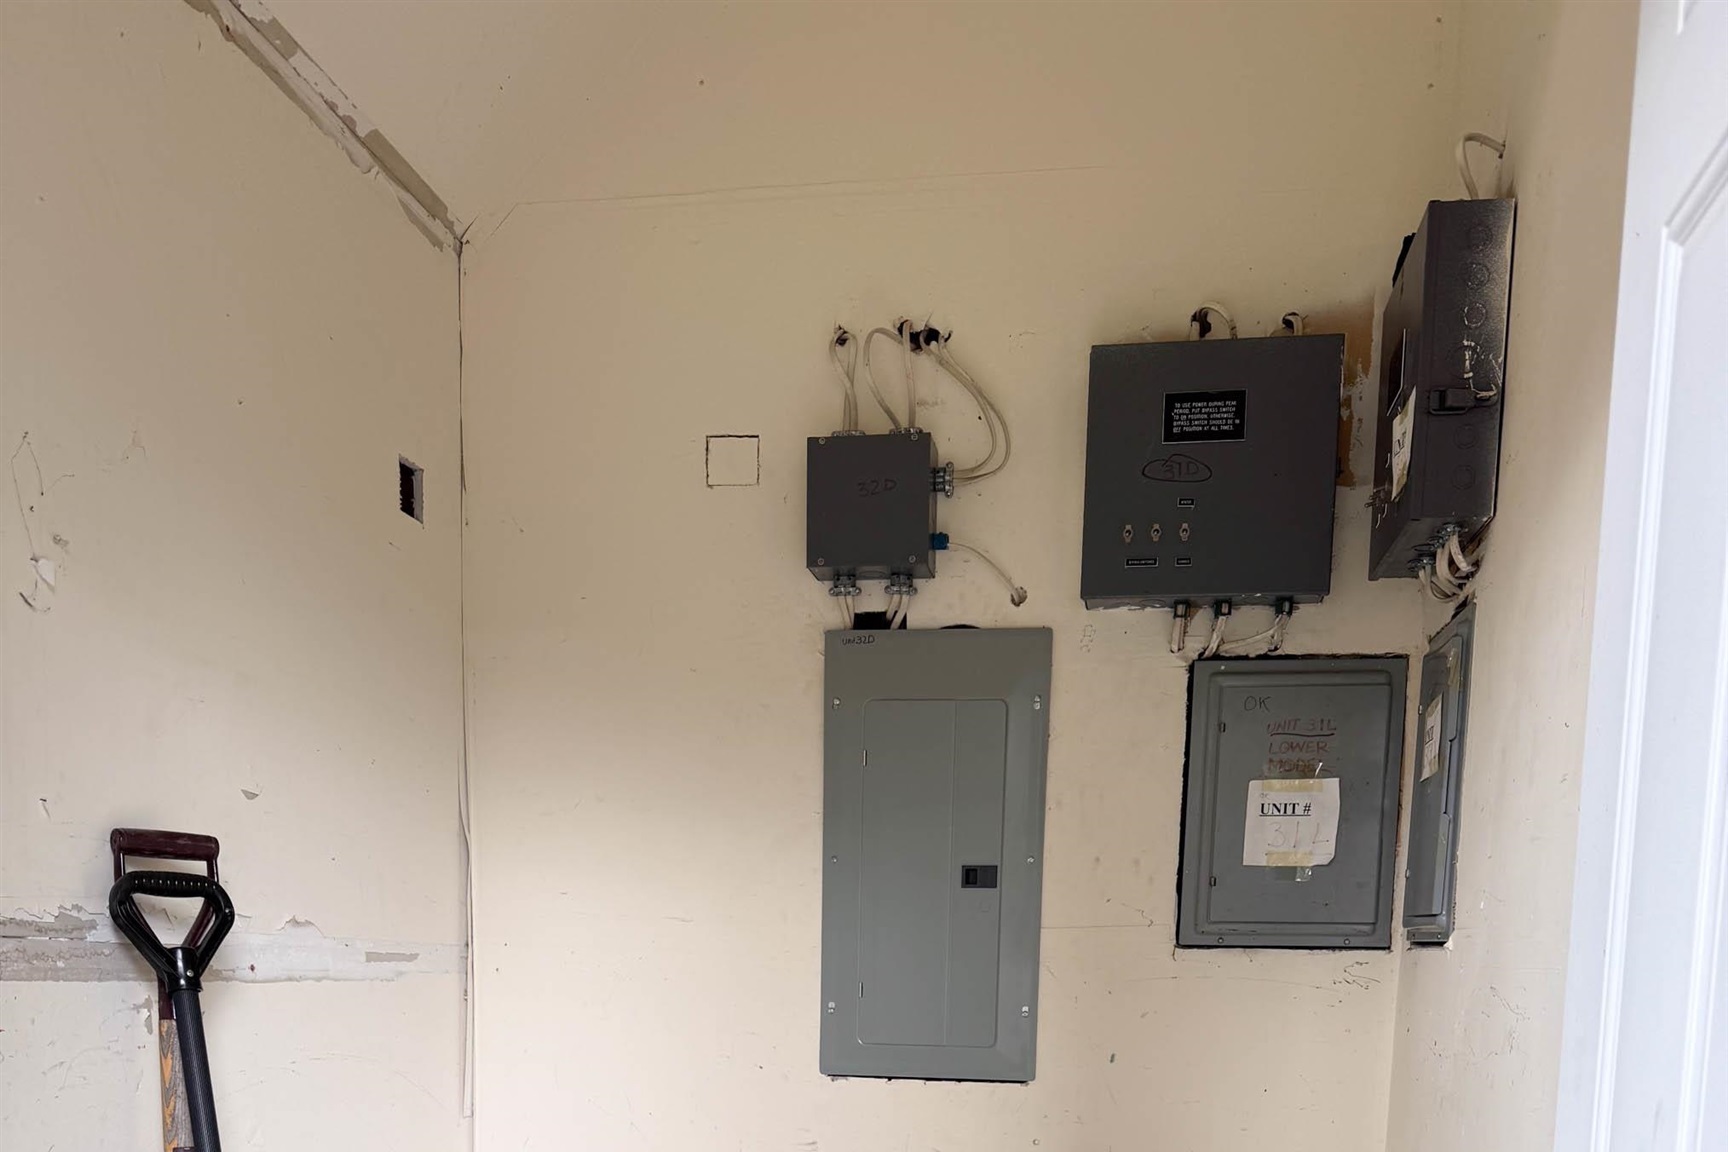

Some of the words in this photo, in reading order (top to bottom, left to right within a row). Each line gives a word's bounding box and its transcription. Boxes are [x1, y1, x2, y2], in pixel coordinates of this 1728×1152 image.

[857, 478, 898, 497] 32D
[1244, 696, 1272, 712] OK
[1266, 718, 1301, 734] UNIT
[1305, 717, 1337, 733] 31L
[1268, 740, 1330, 755] LOWER
[1260, 802, 1300, 815] UNIT
[1302, 802, 1312, 815] #
